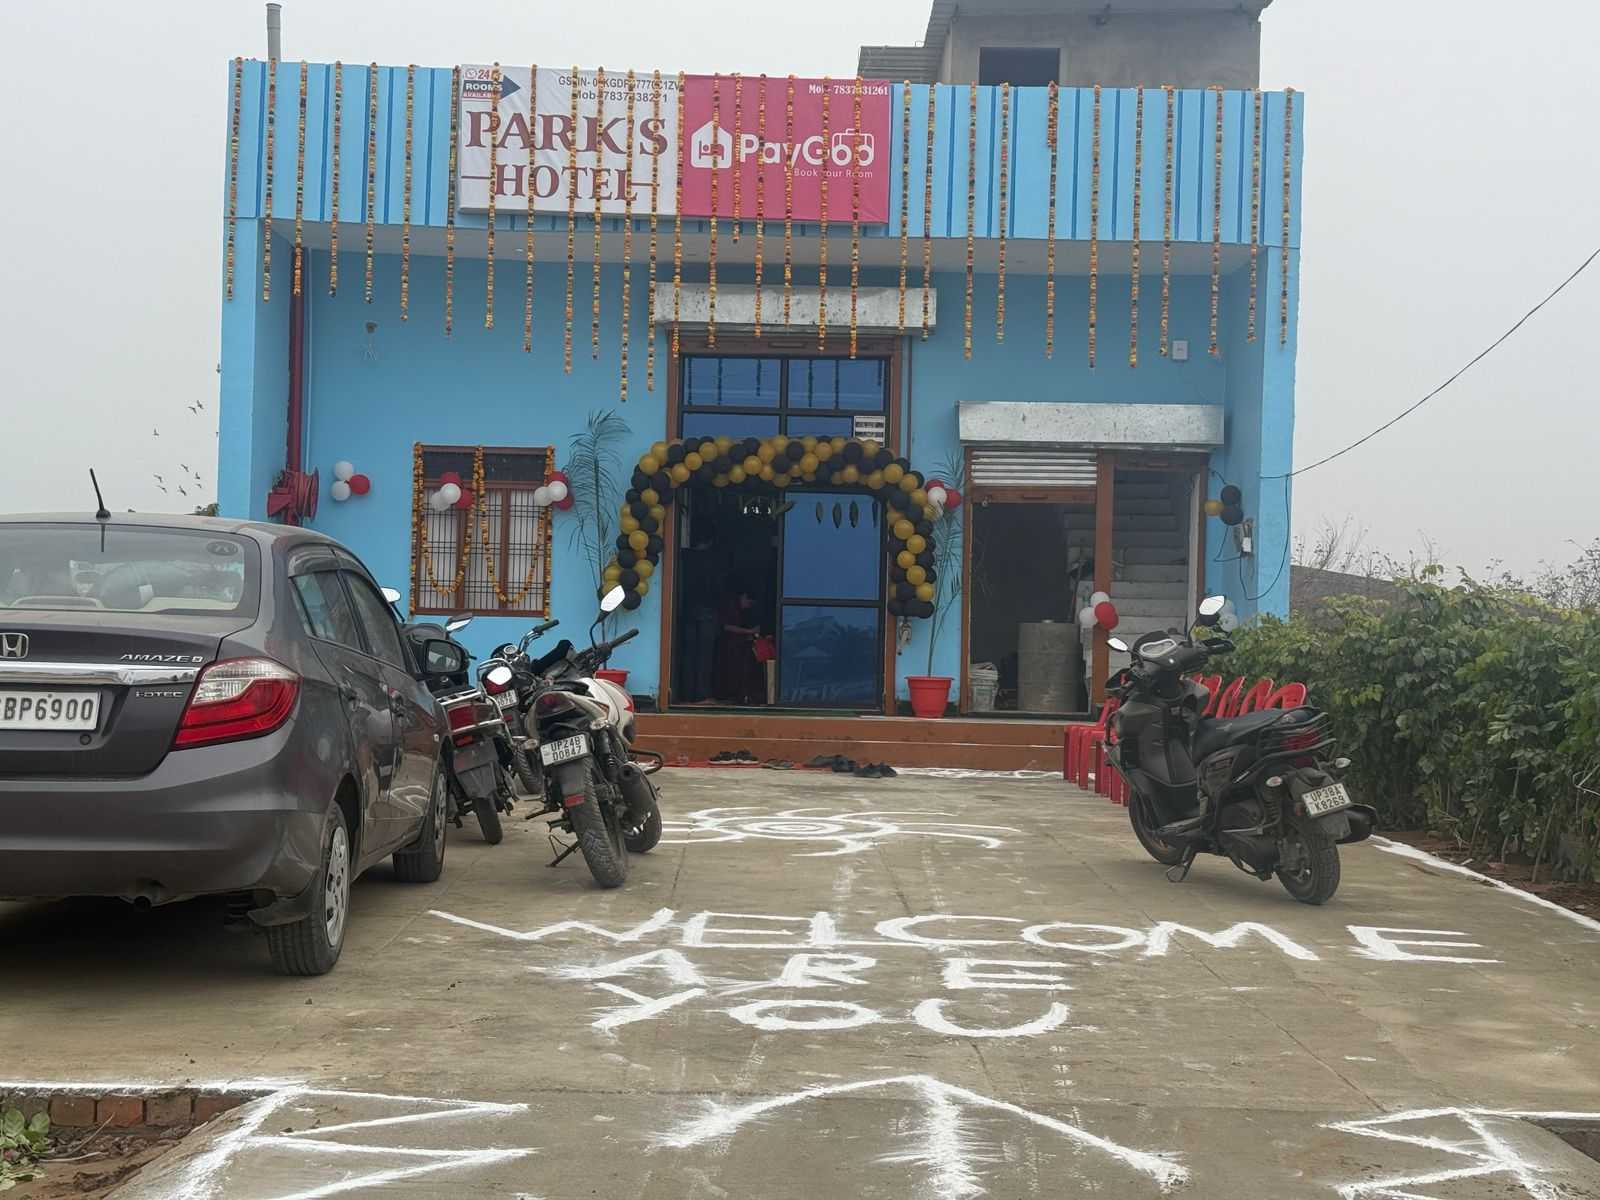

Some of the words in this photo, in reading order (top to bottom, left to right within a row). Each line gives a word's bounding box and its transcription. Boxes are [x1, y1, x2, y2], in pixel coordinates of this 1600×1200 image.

[558, 76, 590, 87] GSIN-
[603, 90, 668, 103] 78373821
[833, 84, 889, 96] 783731261
[819, 168, 842, 178] our
[845, 169, 873, 178] Rom
[494, 163, 638, 201] HOTEL
[119, 653, 191, 663] AMAZE
[0, 696, 94, 721] BP6900
[540, 947, 1074, 991] ARE
[590, 980, 1072, 1038] YOU
